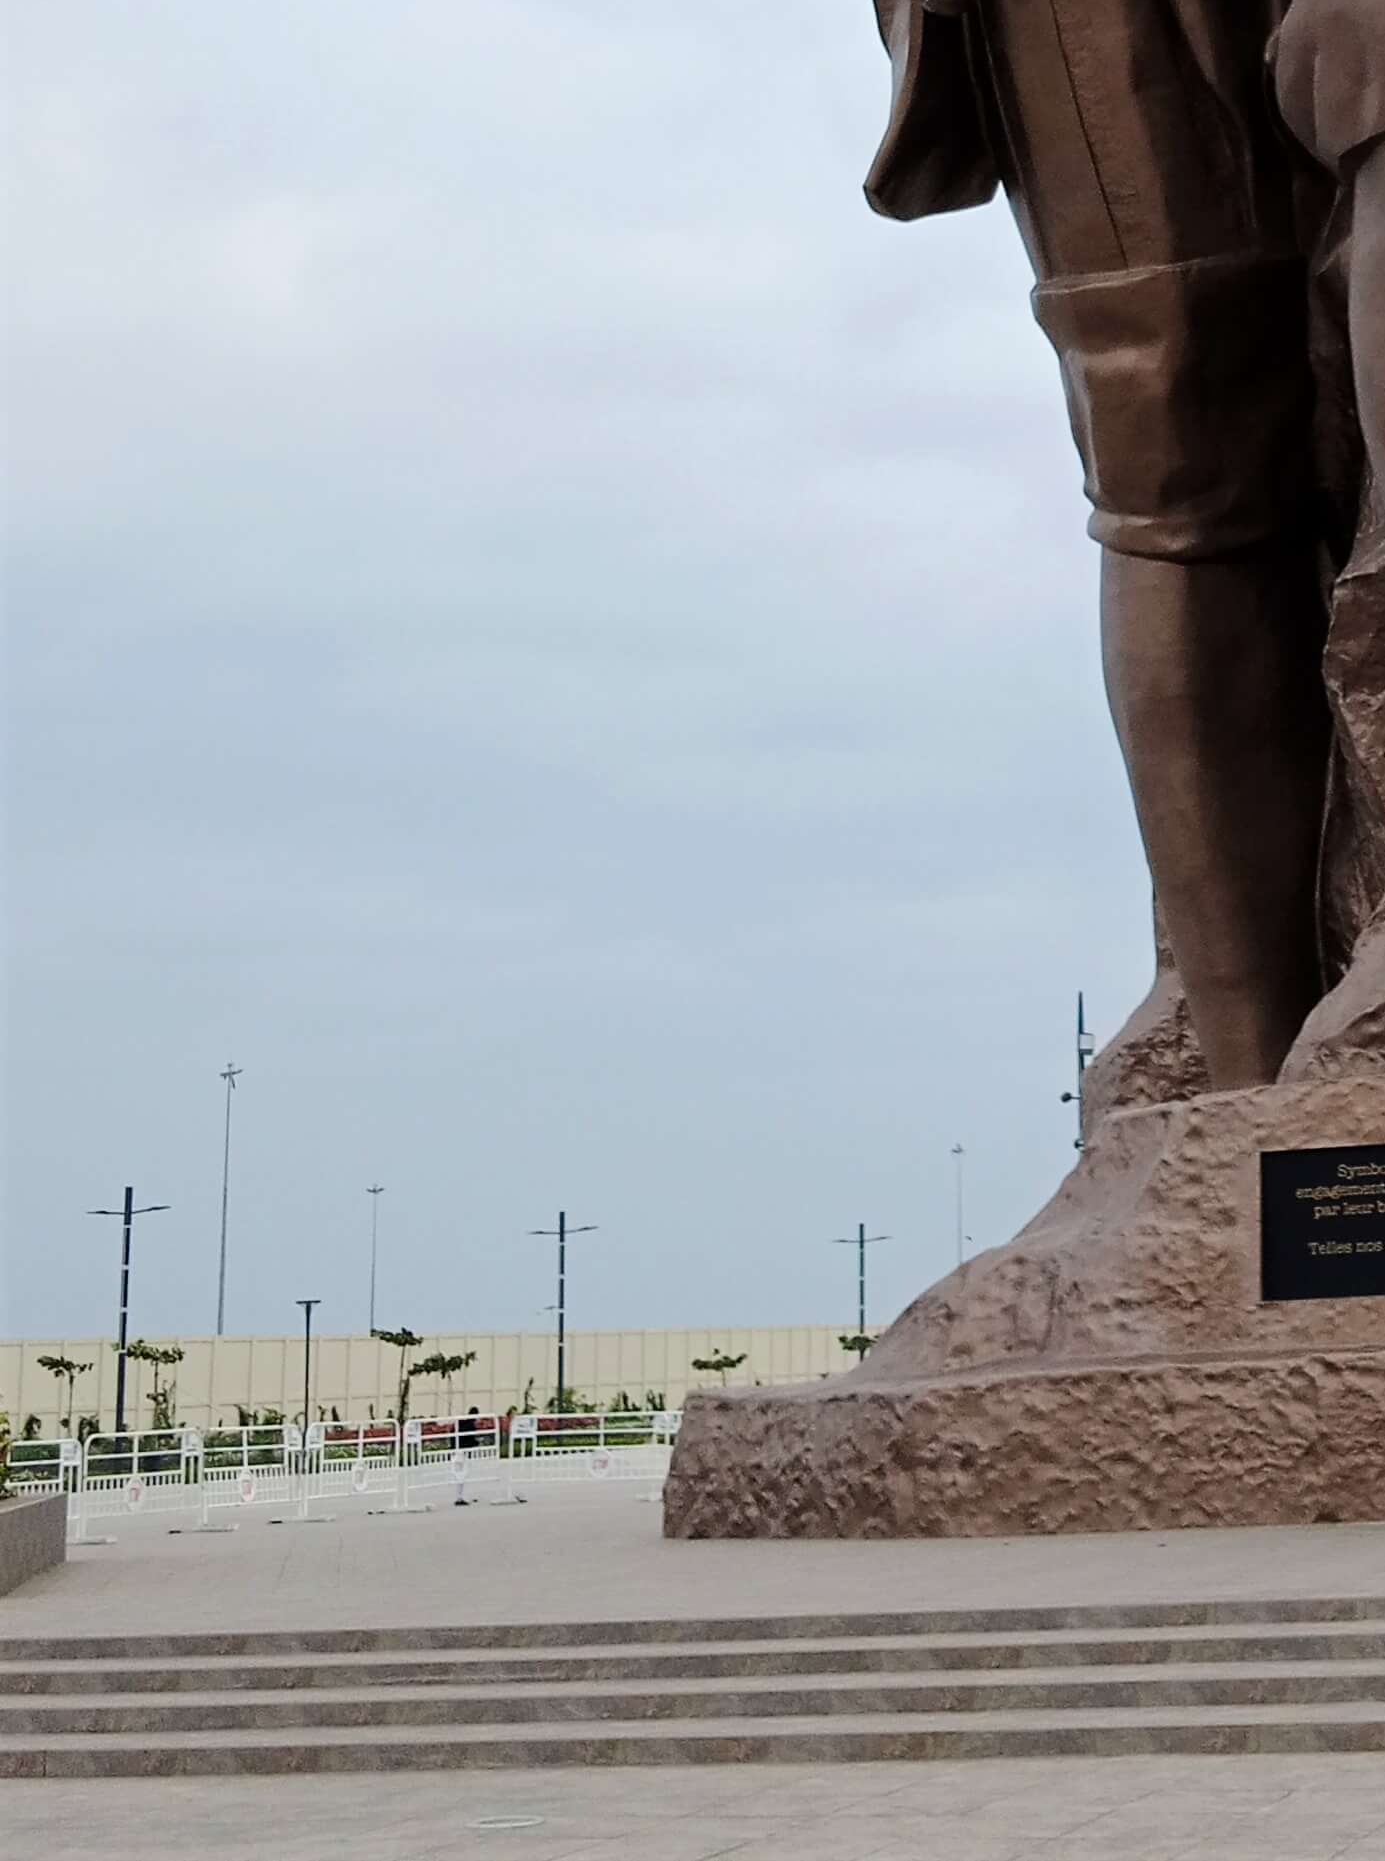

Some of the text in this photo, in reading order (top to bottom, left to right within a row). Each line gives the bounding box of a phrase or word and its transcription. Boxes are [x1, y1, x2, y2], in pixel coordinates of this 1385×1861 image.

[1314, 1205, 1341, 1219] par
[1344, 1202, 1374, 1215] leur
[1309, 1241, 1352, 1255] Telles
[1356, 1240, 1383, 1252] nos
